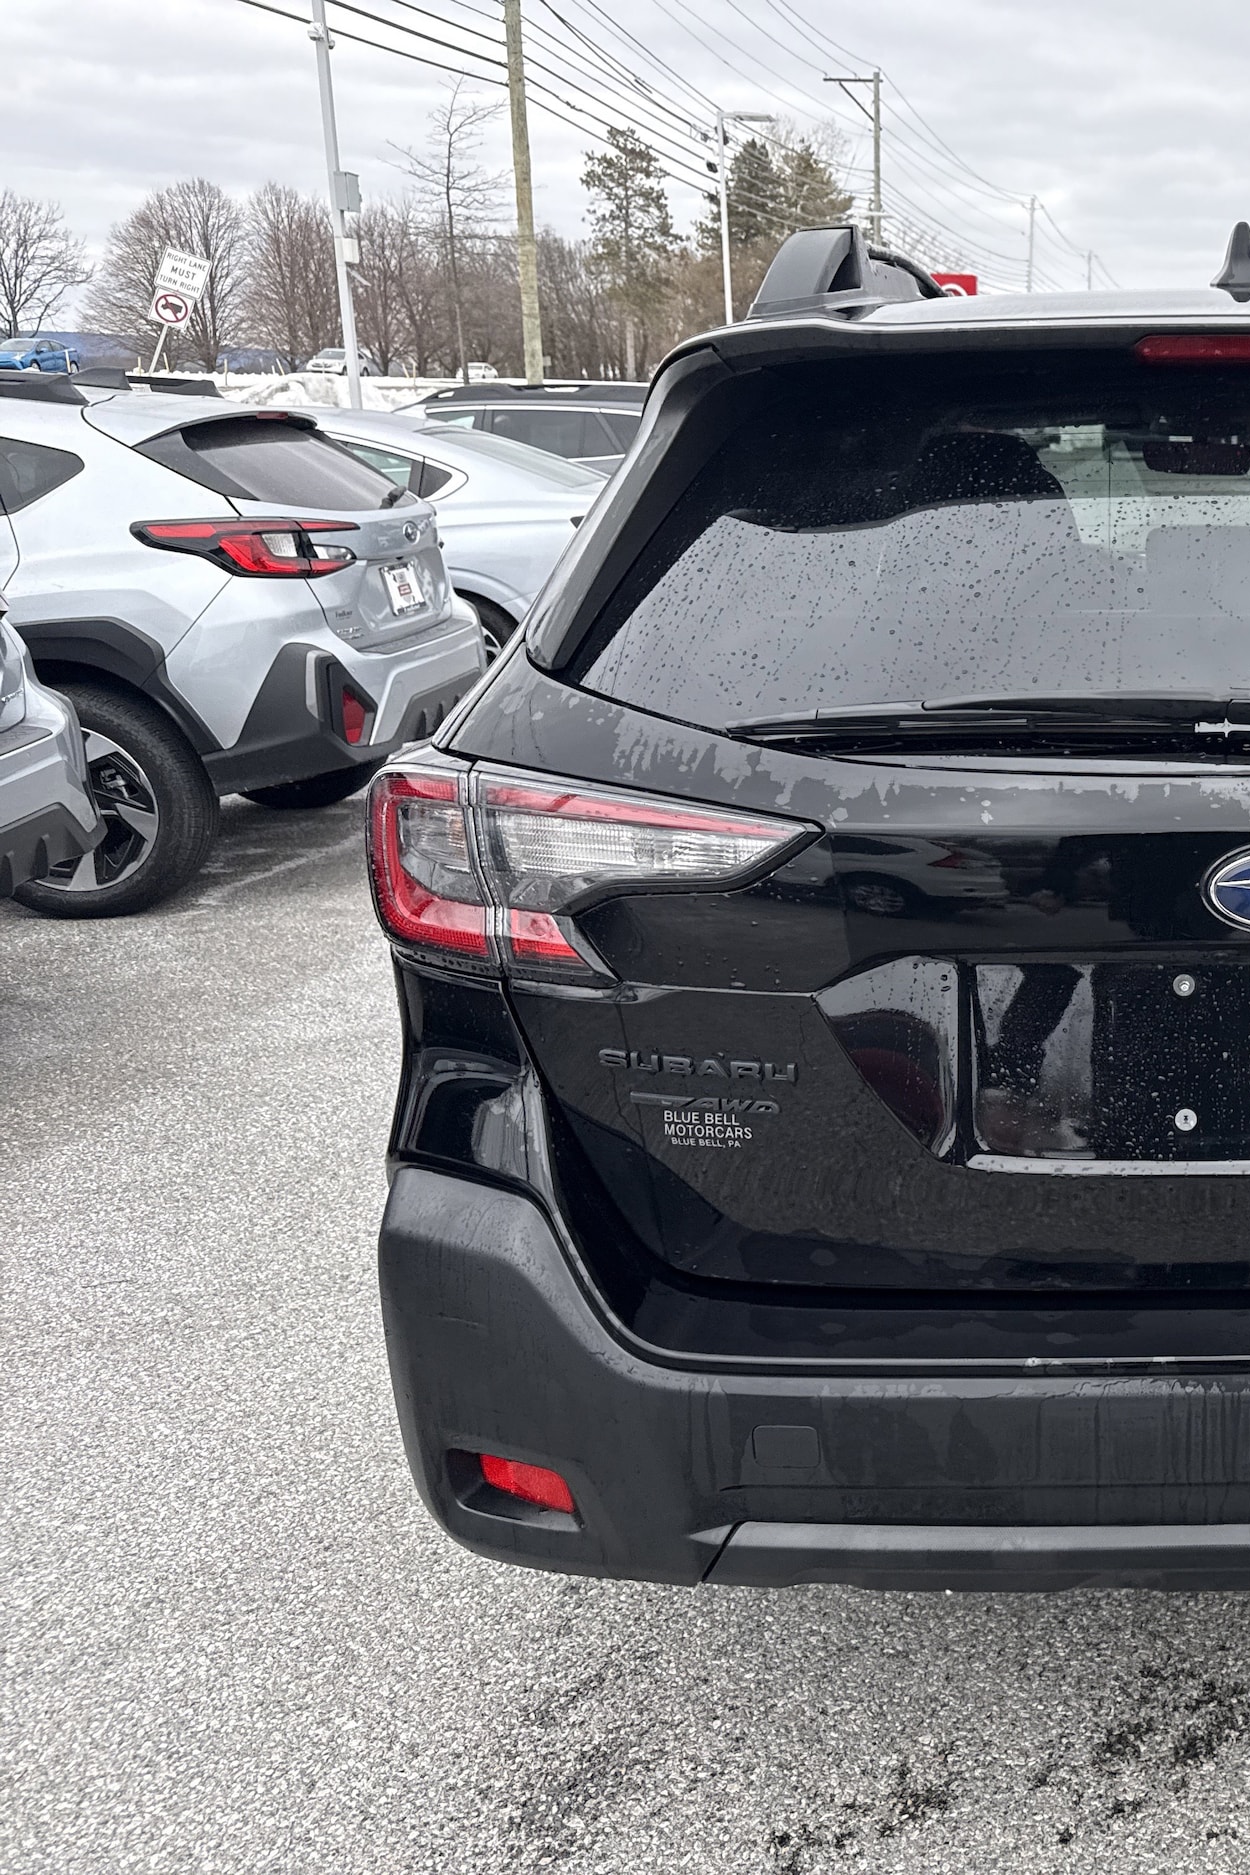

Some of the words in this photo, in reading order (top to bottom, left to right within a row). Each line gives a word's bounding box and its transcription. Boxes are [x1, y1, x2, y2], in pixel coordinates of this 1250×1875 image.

[167, 252, 187, 264] RIGHT
[189, 260, 207, 272] LANE
[170, 265, 196, 280] MUST
[160, 274, 178, 286] TURN
[180, 281, 200, 293] RIGHT
[598, 1048, 798, 1082] SUBARU
[681, 1096, 782, 1115] AWD
[663, 1110, 700, 1124] BLUE
[704, 1112, 740, 1126] BELL
[664, 1123, 753, 1140] MOTORCARS
[671, 1136, 696, 1147] BLUE
[699, 1138, 726, 1149] BELL,
[728, 1139, 742, 1149] PA
